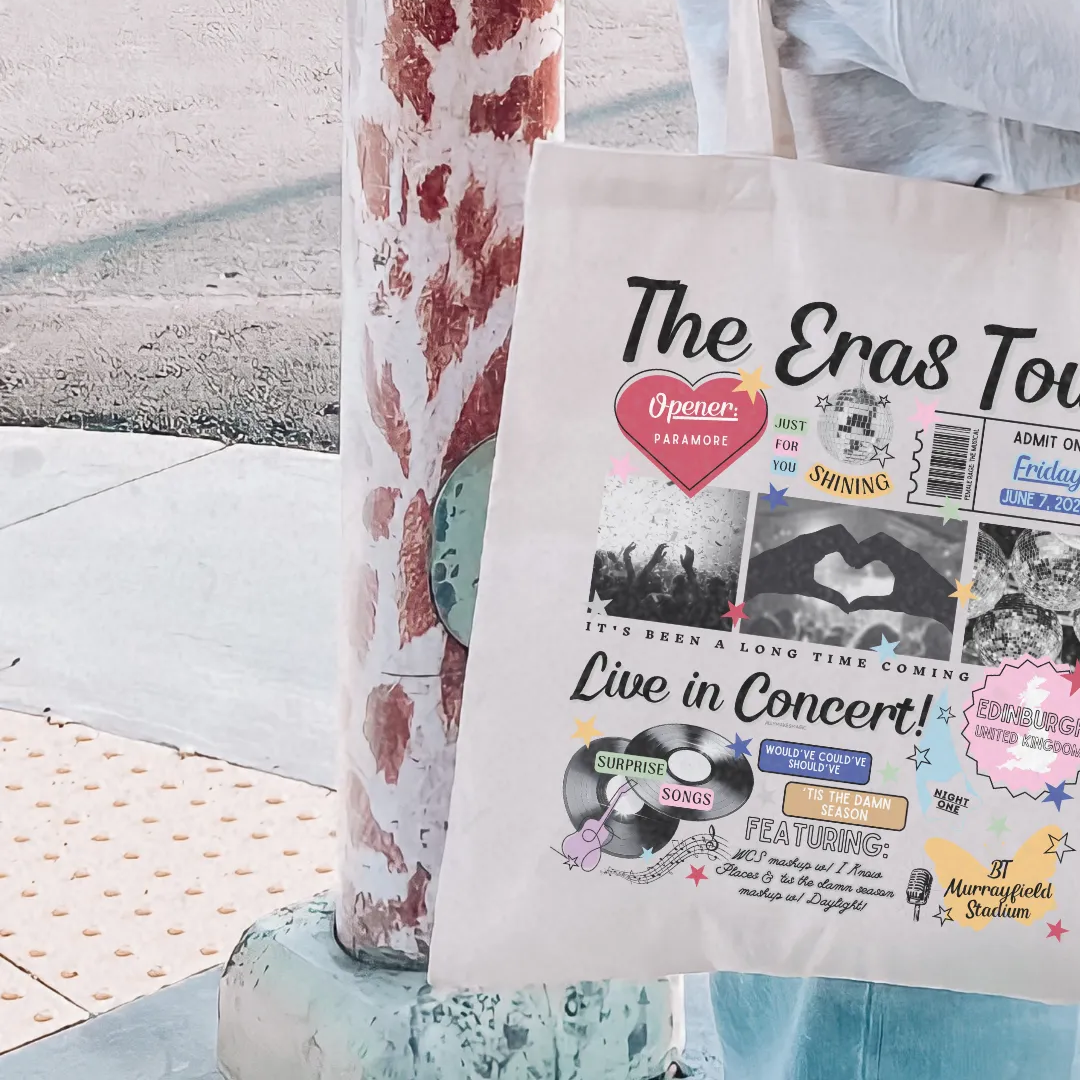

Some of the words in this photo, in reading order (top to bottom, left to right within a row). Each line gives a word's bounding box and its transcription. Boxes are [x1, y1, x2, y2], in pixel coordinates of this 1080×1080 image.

[622, 276, 752, 363] The
[775, 301, 958, 390] Eras
[649, 392, 739, 424] Opener:
[775, 418, 807, 431] JUST
[654, 433, 728, 447] PARAMORE
[775, 438, 799, 452] FOR
[1013, 431, 1058, 448] ADMIT
[773, 459, 796, 473] YOU
[964, 480, 973, 500] FEMALE
[971, 429, 980, 452] MUSICAL
[809, 465, 890, 495] SHINING
[1002, 490, 1035, 507] JUNE
[1039, 494, 1050, 511] 7,
[586, 621, 631, 636] IT'S
[645, 629, 701, 646] BEEN
[714, 639, 725, 649] A
[740, 642, 798, 659] LONG
[812, 651, 867, 668] TIME
[881, 661, 970, 682] COMING
[569, 650, 670, 703] Live
[682, 671, 724, 712] in
[734, 672, 933, 737] Concert!
[974, 724, 1018, 745] UNITED
[597, 755, 665, 776] SURPRISE
[765, 744, 815, 760] WOULD'VE
[818, 752, 867, 767] COULD'VE
[788, 759, 841, 775] SHOULD'VE
[661, 787, 712, 806] SONGS
[802, 787, 824, 801] 'TIS
[829, 790, 850, 805] THE
[854, 794, 891, 810] DAMN
[934, 788, 969, 807] NIGHT
[937, 800, 961, 814] ONE
[821, 804, 868, 821] SEASON
[745, 816, 890, 859] FEATURING:
[731, 848, 767, 862] WCS
[768, 857, 812, 871] mashup
[815, 863, 834, 872] w/
[835, 862, 848, 873] I
[847, 863, 883, 878] Know
[987, 859, 1013, 879] BT
[715, 863, 759, 879] Places
[761, 870, 773, 883] &
[797, 875, 814, 887] the
[817, 879, 853, 892] damn
[856, 886, 894, 898] season
[943, 877, 1053, 904] Murrayfield
[738, 887, 783, 902] mashup
[785, 893, 805, 902] w/
[806, 892, 868, 914] Daylight!
[965, 899, 1031, 919] Stadium
